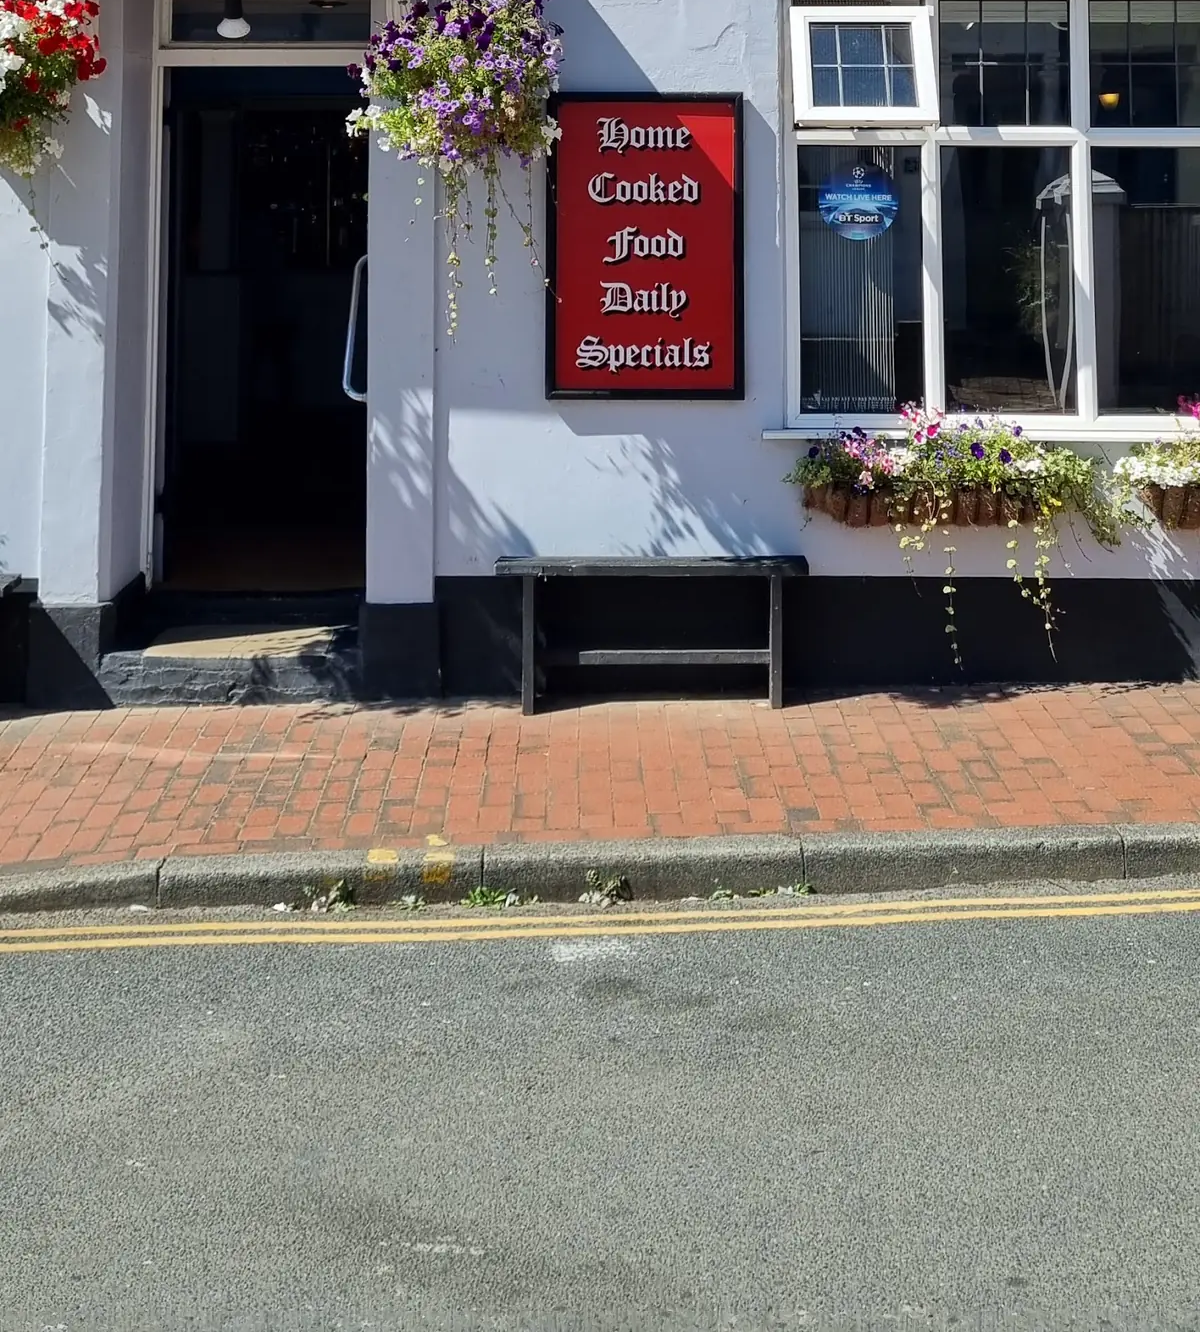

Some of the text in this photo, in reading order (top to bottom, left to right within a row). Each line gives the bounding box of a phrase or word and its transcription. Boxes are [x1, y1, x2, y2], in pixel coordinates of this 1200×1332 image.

[596, 116, 692, 154] Home
[588, 171, 701, 204] Cooked
[825, 193, 852, 201] WATCH
[838, 212, 879, 224] BT Sport
[602, 225, 685, 264] Food
[599, 280, 688, 319] Daily
[575, 334, 711, 372] Specials
